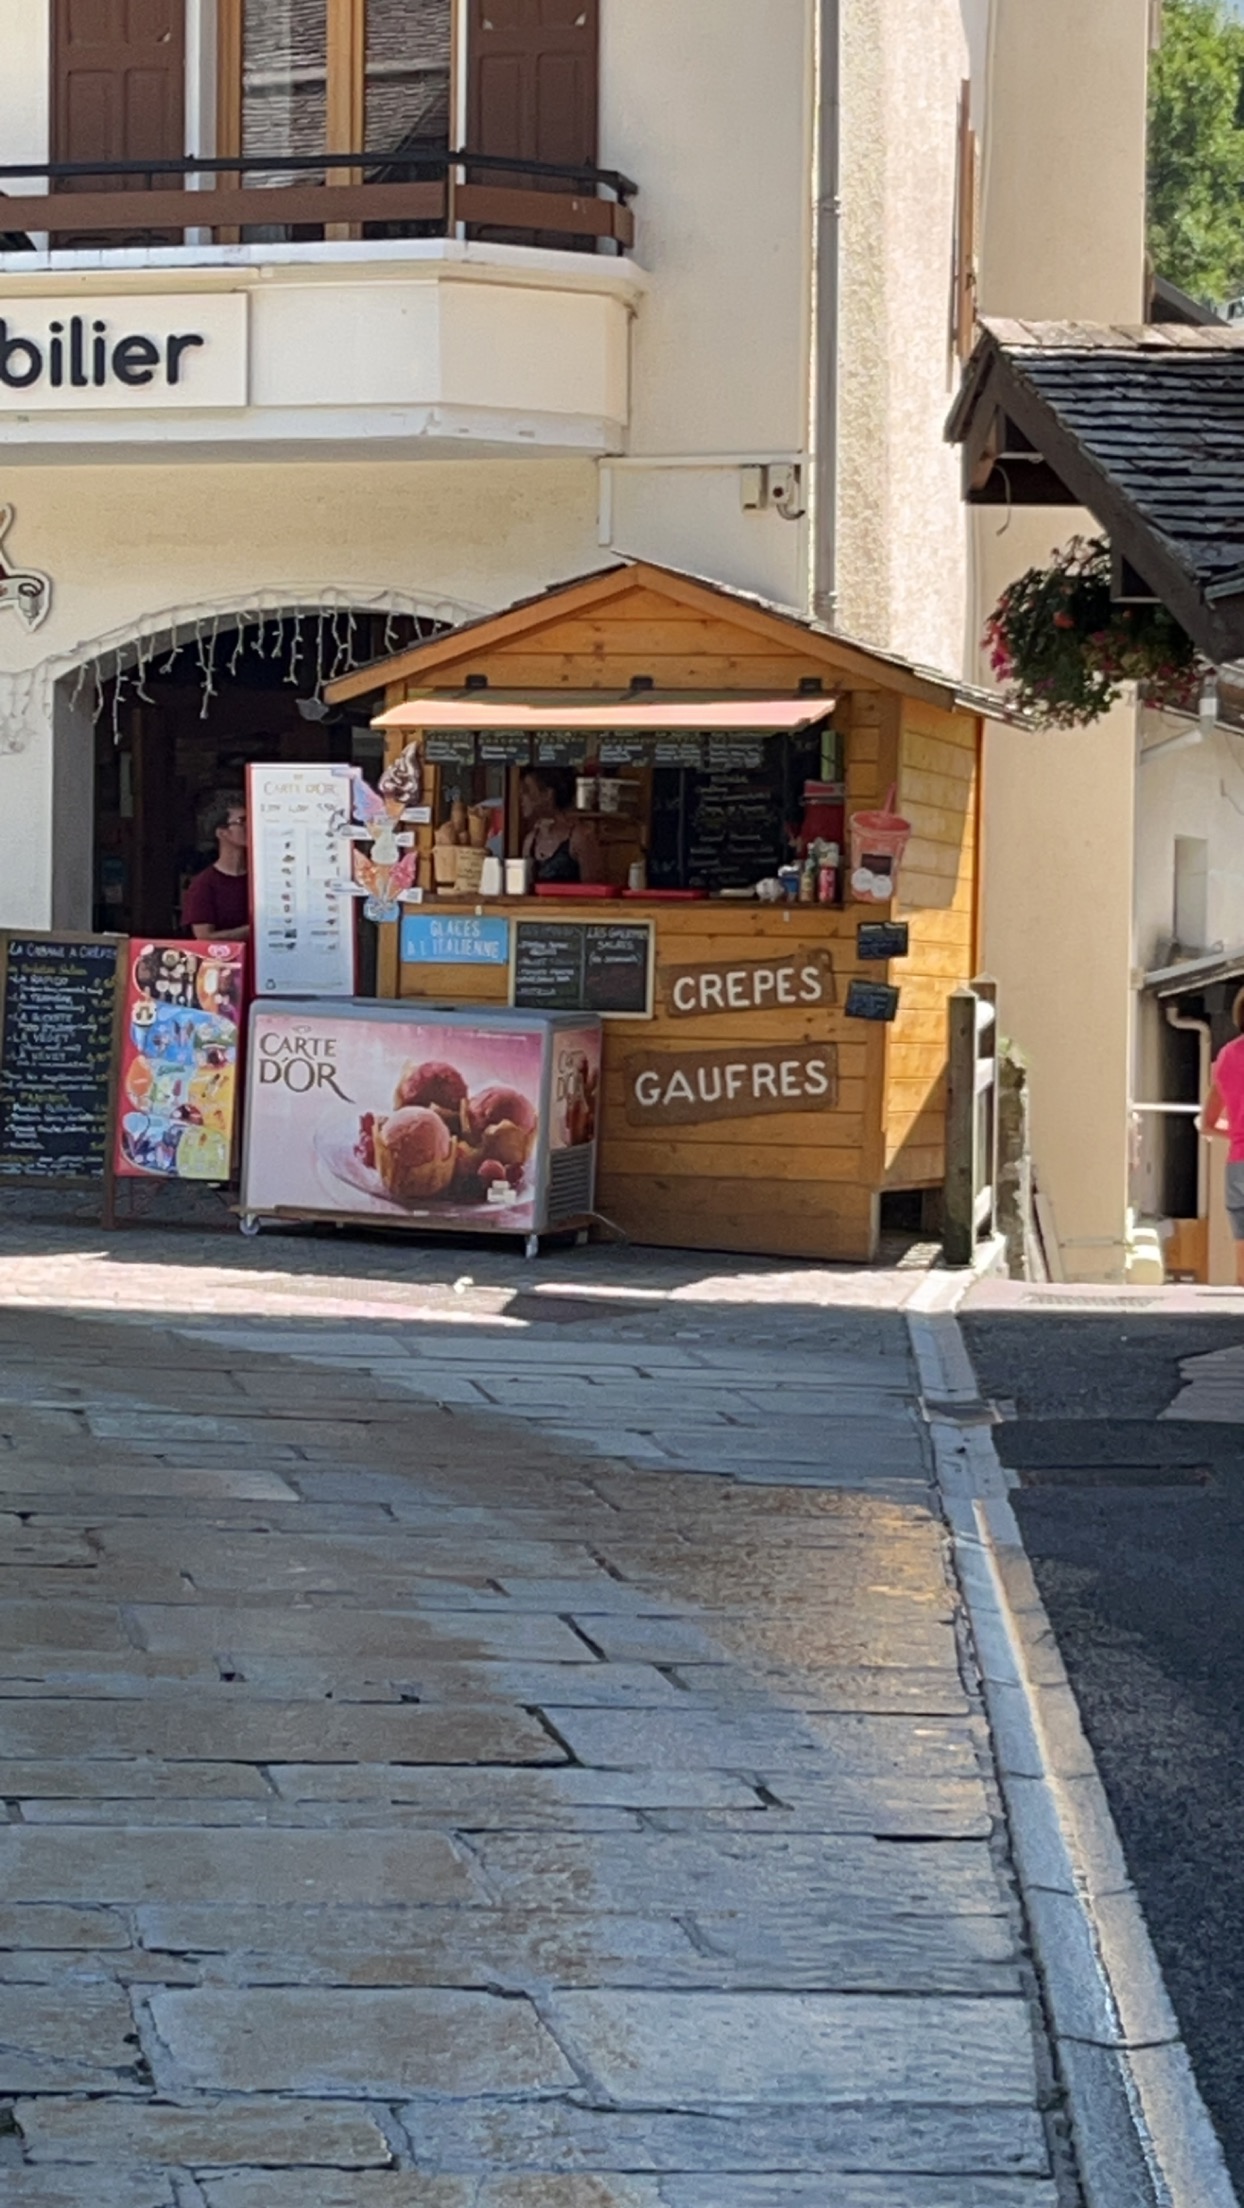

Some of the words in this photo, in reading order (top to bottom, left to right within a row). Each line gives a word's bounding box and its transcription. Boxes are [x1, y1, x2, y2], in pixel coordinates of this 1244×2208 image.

[0, 315, 204, 388] bilier
[430, 920, 481, 937] GLACES
[672, 967, 822, 1011] CREPES
[260, 1032, 337, 1061] CARTE
[259, 1057, 356, 1105] D'OR
[634, 1060, 829, 1107] GAUFRES
